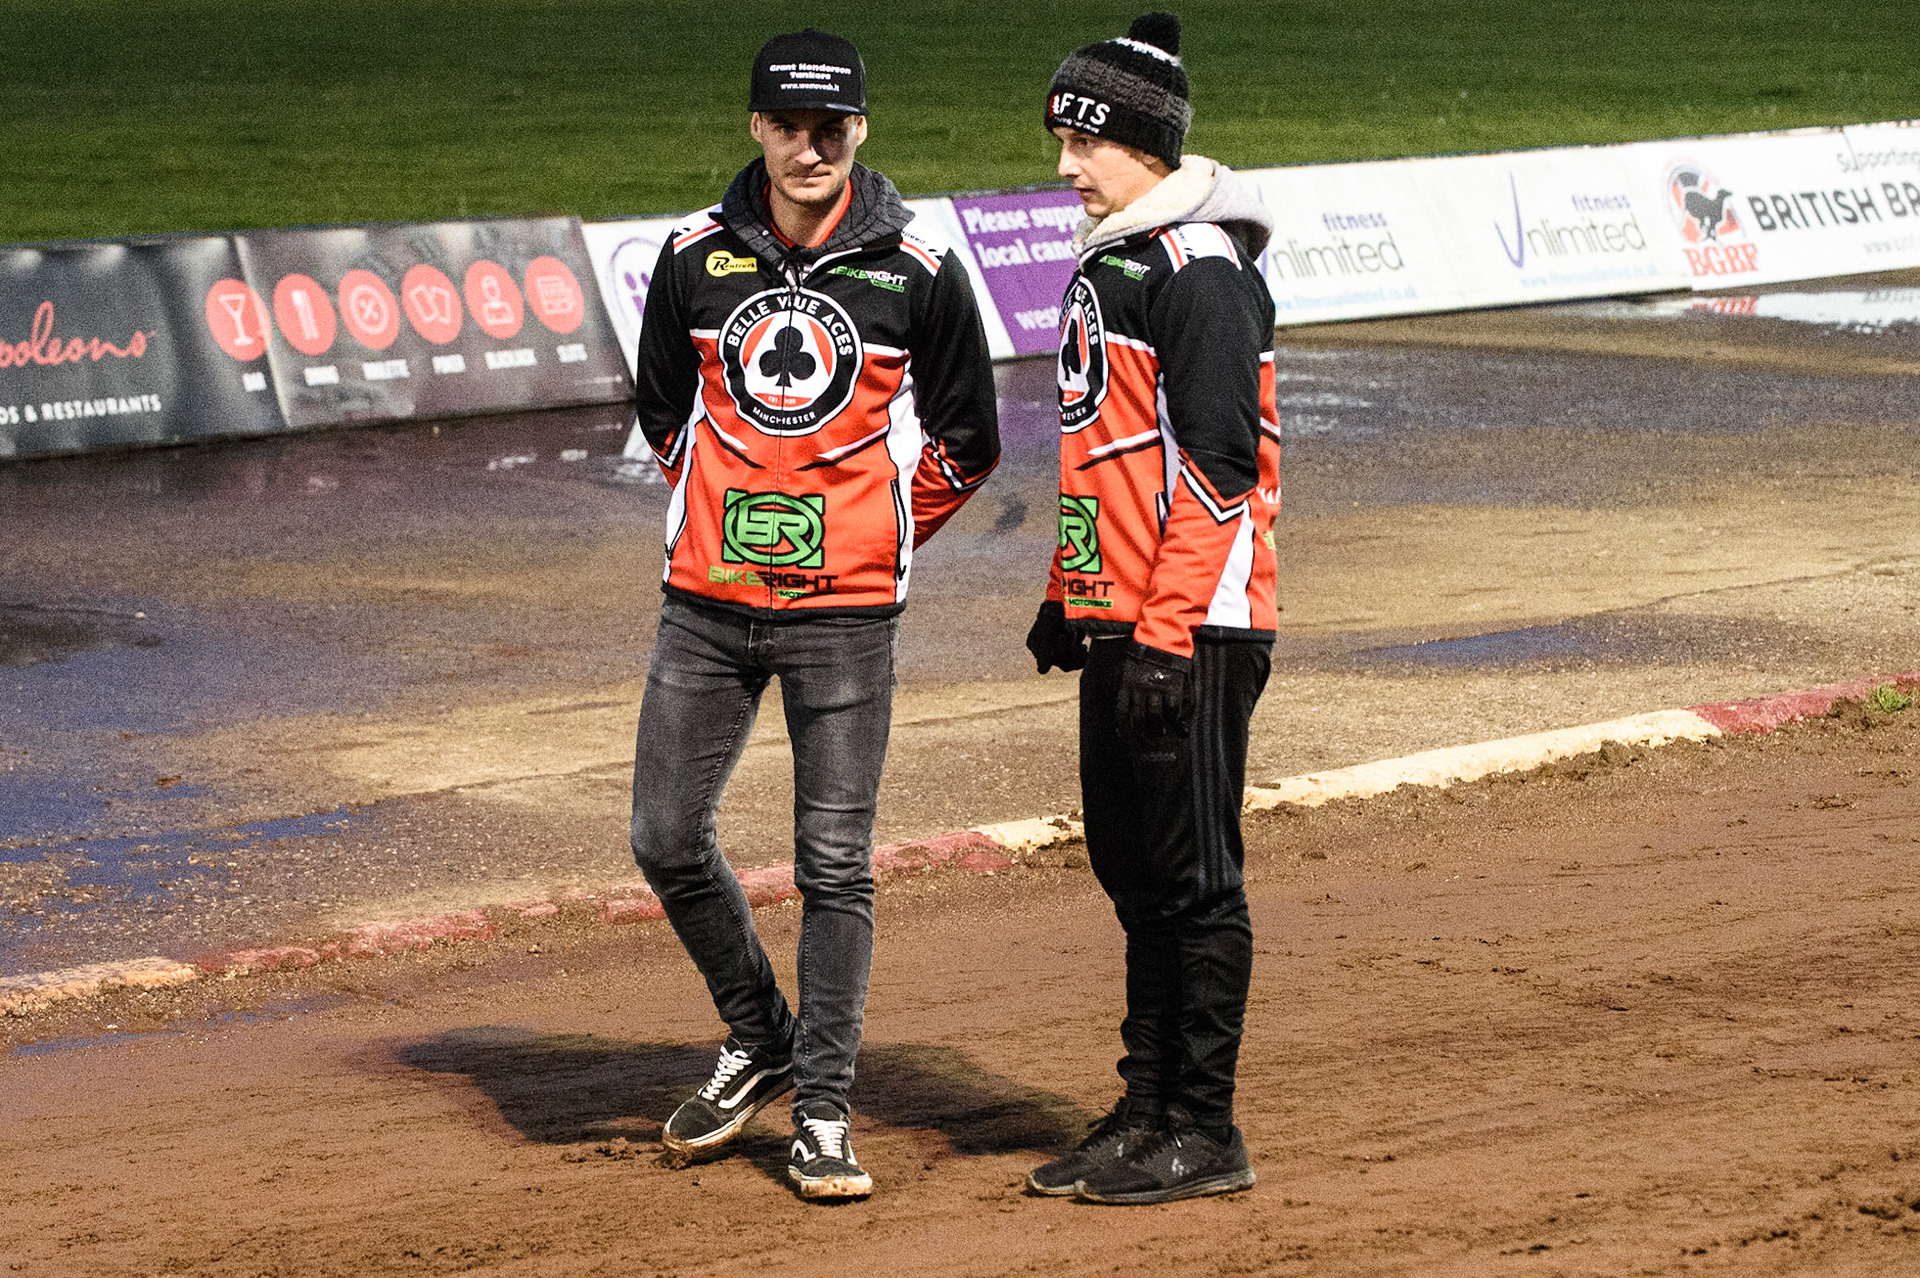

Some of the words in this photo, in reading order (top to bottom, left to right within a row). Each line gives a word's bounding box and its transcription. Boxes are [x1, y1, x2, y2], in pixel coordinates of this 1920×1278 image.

[769, 64, 797, 72] Grant
[798, 63, 852, 75] Henderson
[789, 71, 831, 80] Tankers
[1572, 193, 1630, 212] fitness
[1747, 186, 1883, 231] BRITISH
[961, 207, 1030, 234] Please
[1322, 213, 1388, 231] fitness
[974, 238, 1032, 269] local
[1682, 243, 1759, 277] BGBF
[726, 300, 771, 347] BELLE
[821, 313, 853, 356] ACES
[1083, 301, 1099, 345] ACES
[40, 393, 162, 421] RESTAURANTS
[752, 406, 817, 425] MANCHESTER
[708, 565, 839, 590] BIKERIGHT
